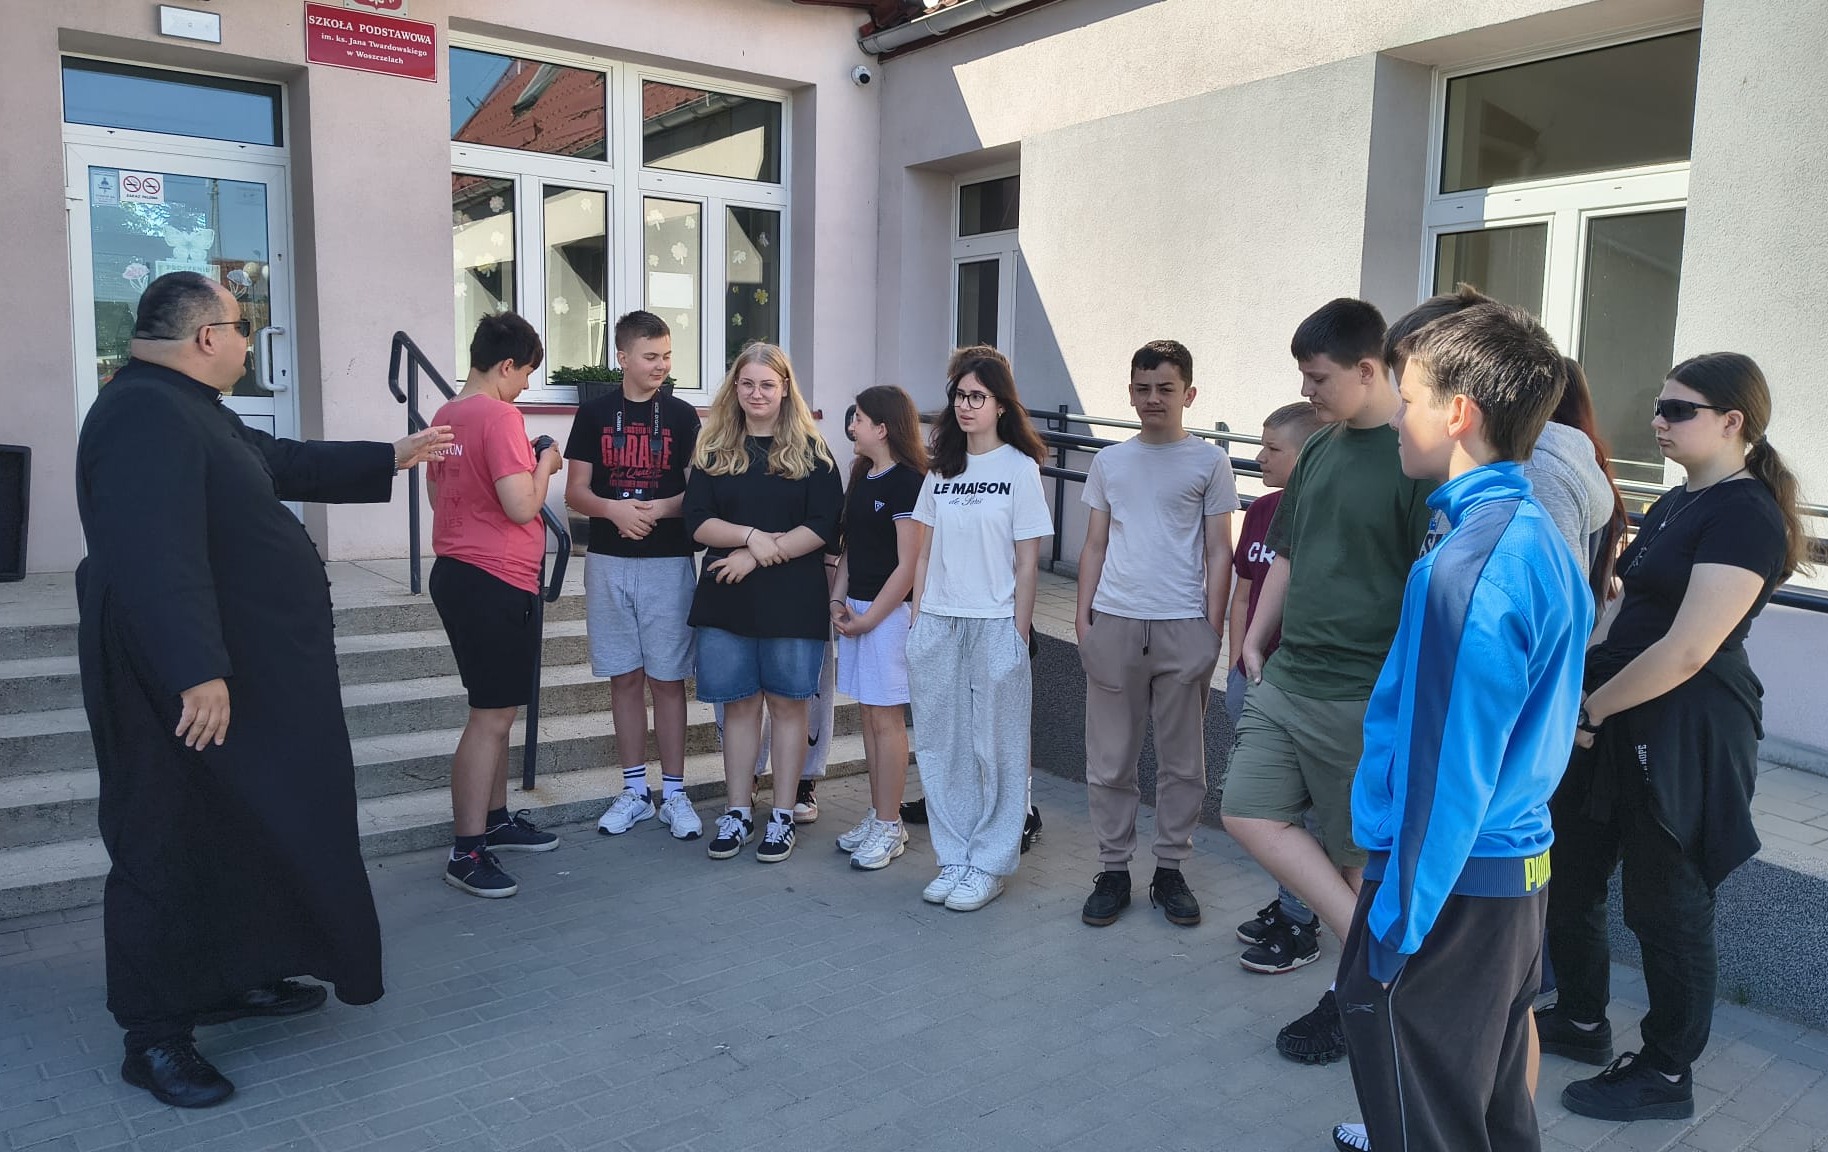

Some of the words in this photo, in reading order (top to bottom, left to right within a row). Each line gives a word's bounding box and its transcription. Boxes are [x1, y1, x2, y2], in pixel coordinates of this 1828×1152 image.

[308, 15, 353, 31] SZKOŁA
[359, 24, 432, 45] PODSTAWOWA
[321, 33, 334, 41] im.
[336, 35, 348, 43] ks.
[348, 37, 367, 46] Jana
[369, 40, 428, 57] Twardowskiego
[355, 50, 404, 64] Woszczelach
[934, 483, 950, 494] LE
[952, 482, 1011, 495] MAISON
